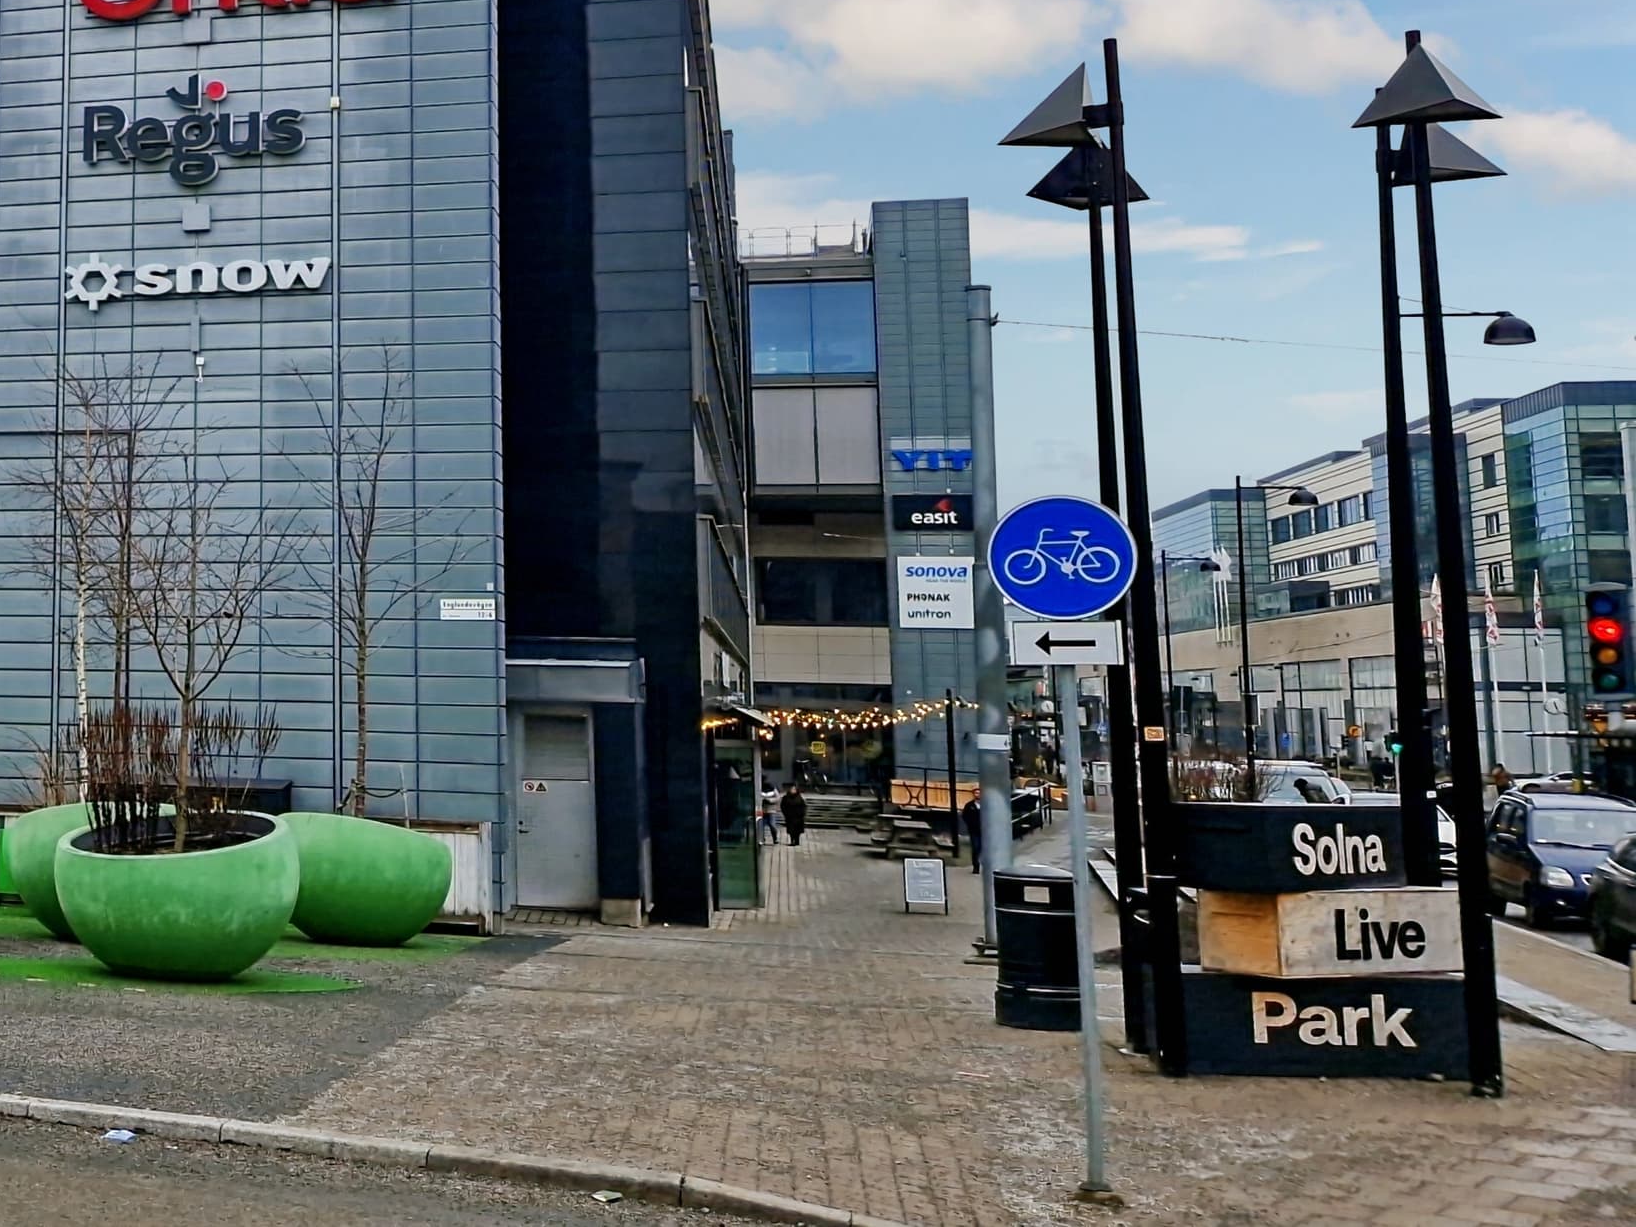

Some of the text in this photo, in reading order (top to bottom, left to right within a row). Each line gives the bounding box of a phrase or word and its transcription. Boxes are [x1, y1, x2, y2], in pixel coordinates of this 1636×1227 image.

[82, 104, 306, 186] Regus
[133, 256, 332, 295] snow
[911, 510, 959, 525] easit
[905, 566, 968, 578] sonova
[907, 593, 951, 602] PHONAK
[907, 608, 952, 619] unitron
[1293, 823, 1387, 876] Solna
[1334, 908, 1427, 962] Live
[1251, 991, 1418, 1049] Park
